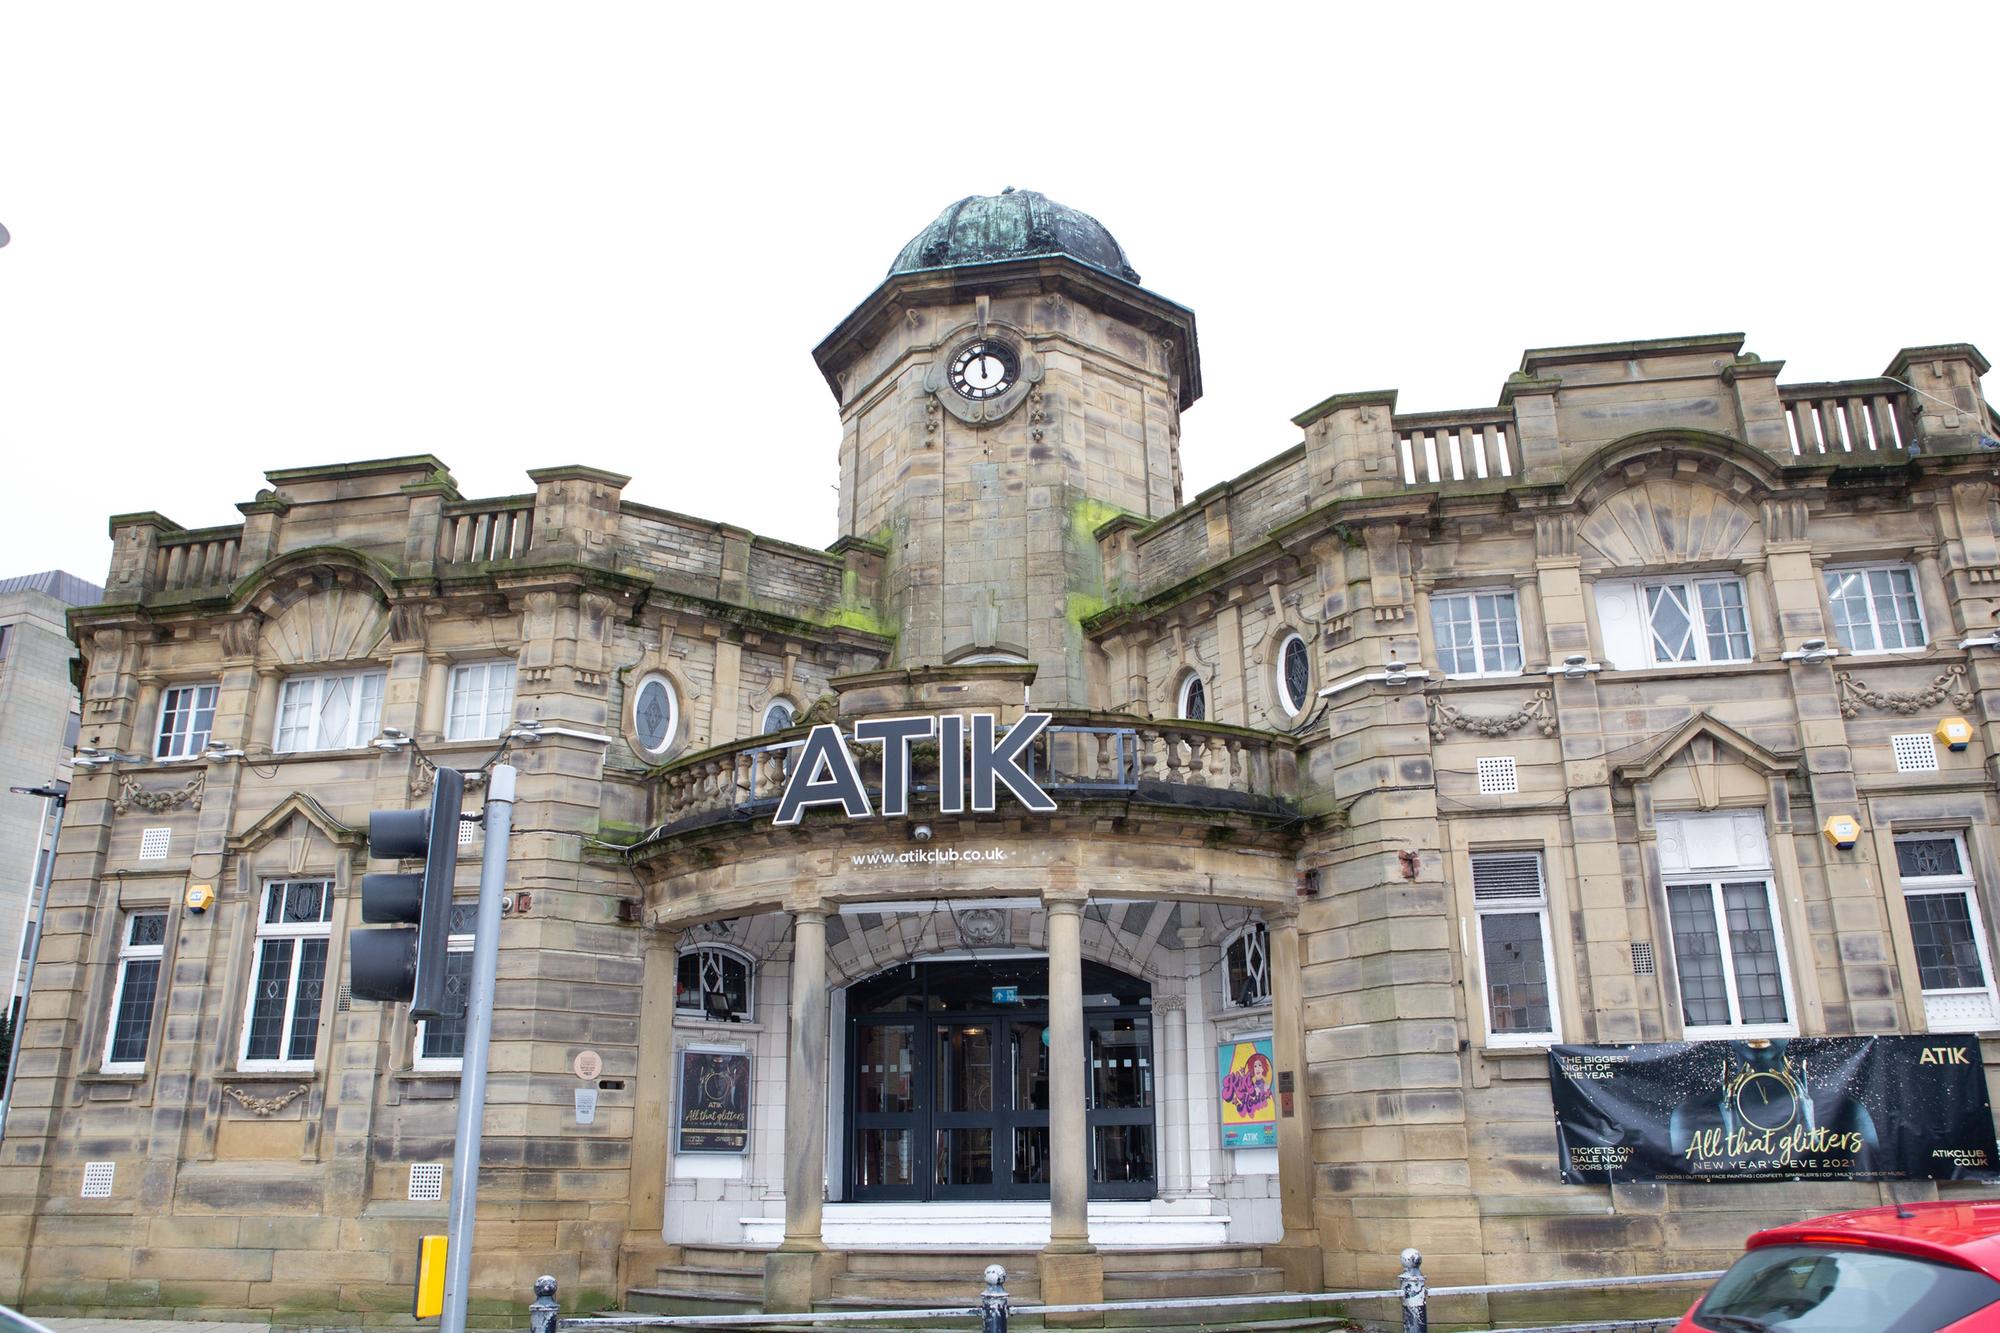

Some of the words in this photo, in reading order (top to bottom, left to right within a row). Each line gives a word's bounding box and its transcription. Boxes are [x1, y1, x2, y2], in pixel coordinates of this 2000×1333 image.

[772, 712, 1058, 825] ATIK
[852, 848, 1005, 866] www.atikclub.co.uk
[1560, 1056, 1582, 1064] THE
[1583, 1055, 1630, 1064] BIGGEST
[1920, 1047, 1970, 1065] ATIK
[1561, 1063, 1594, 1072] NIGHT
[1595, 1063, 1611, 1072] OF
[1562, 1072, 1584, 1080] THE
[1584, 1071, 1614, 1080] YEAR
[1685, 1127, 1724, 1160] All
[1725, 1126, 1776, 1158] that
[1778, 1124, 1865, 1166] glitters
[1570, 1146, 1616, 1155] TICKETS
[1617, 1146, 1634, 1154] ON
[1571, 1155, 1599, 1163] SALE
[1601, 1155, 1628, 1163] NOW
[1954, 1158, 1988, 1166] CO.UK
[1693, 1161, 1724, 1170] NEW
[1729, 1160, 1781, 1169] YEAR'S
[1790, 1159, 1818, 1168] EVE
[1822, 1159, 1857, 1168] 2021
